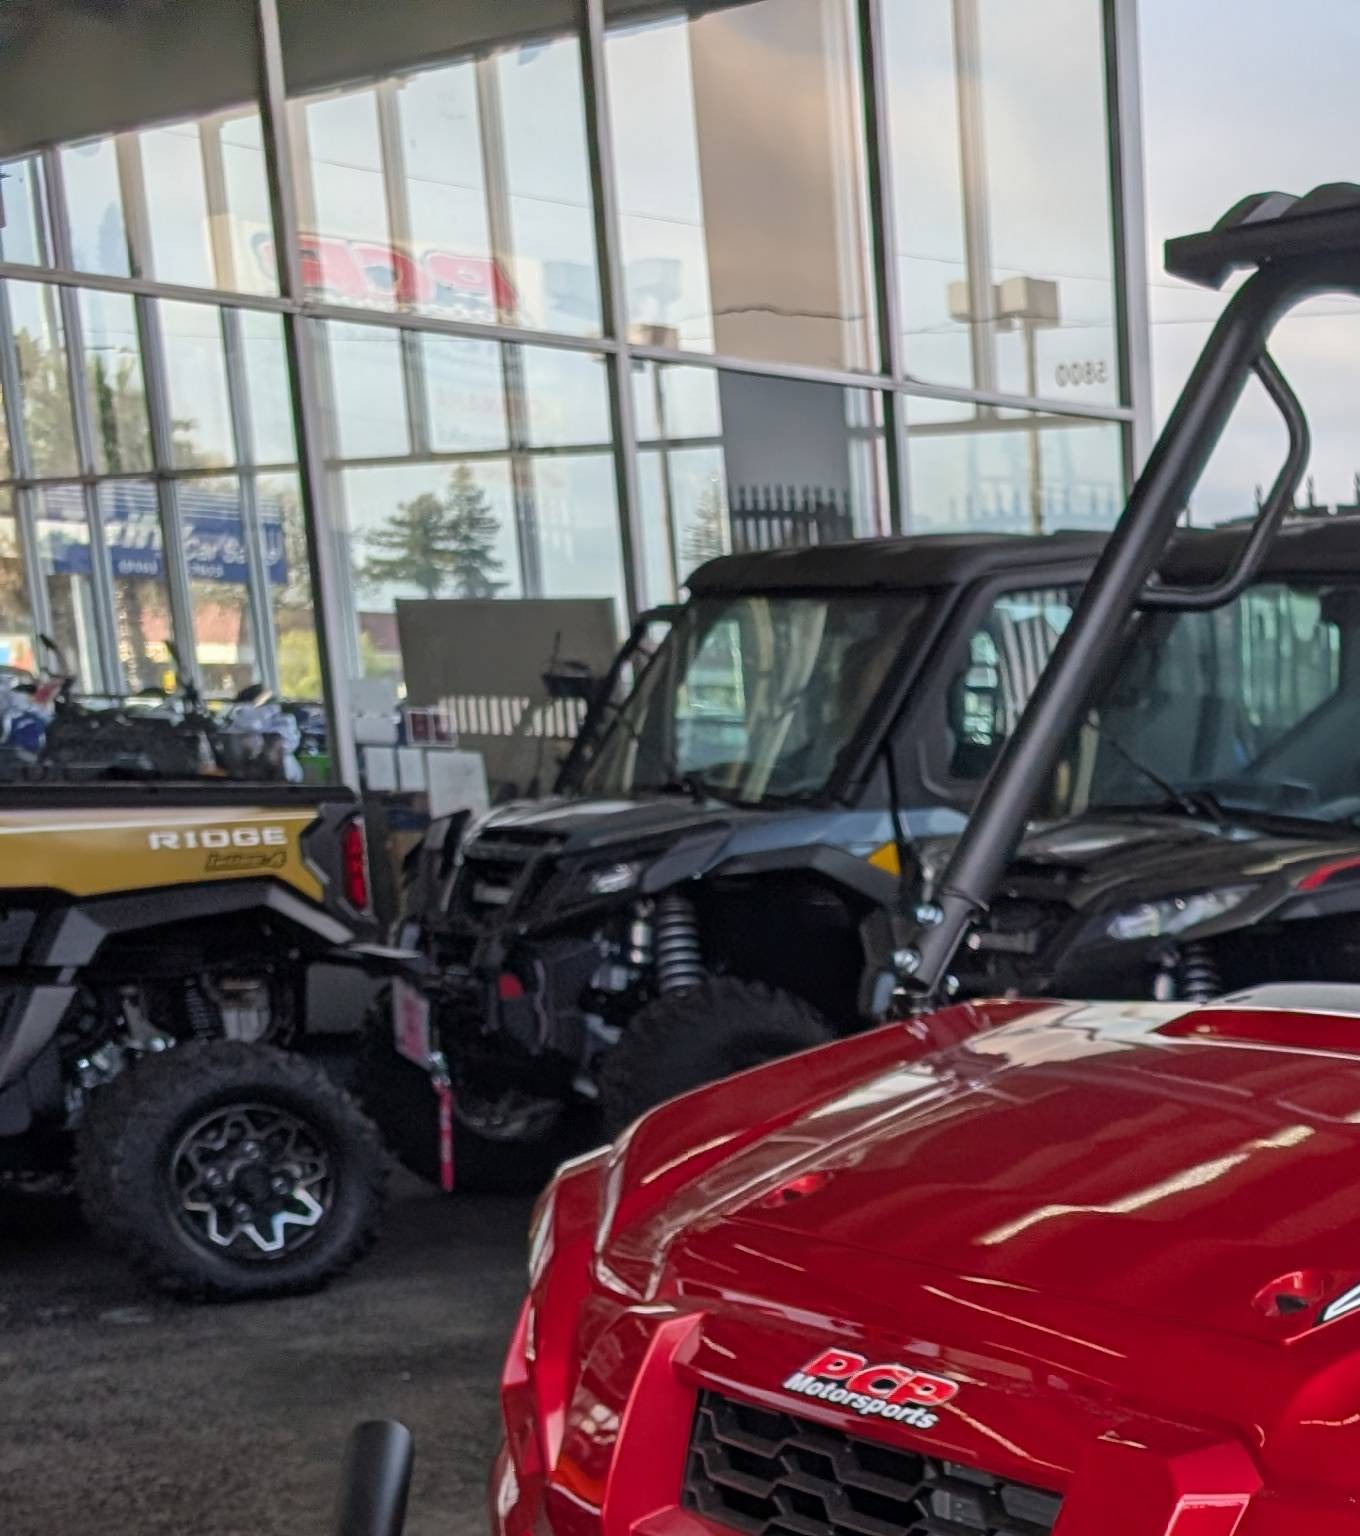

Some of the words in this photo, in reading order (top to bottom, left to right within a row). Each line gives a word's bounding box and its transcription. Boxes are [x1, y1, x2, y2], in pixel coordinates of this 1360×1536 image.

[148, 826, 288, 850] RIDGE
[783, 1374, 939, 1429] Motorsports
[803, 1348, 958, 1406] PCP
